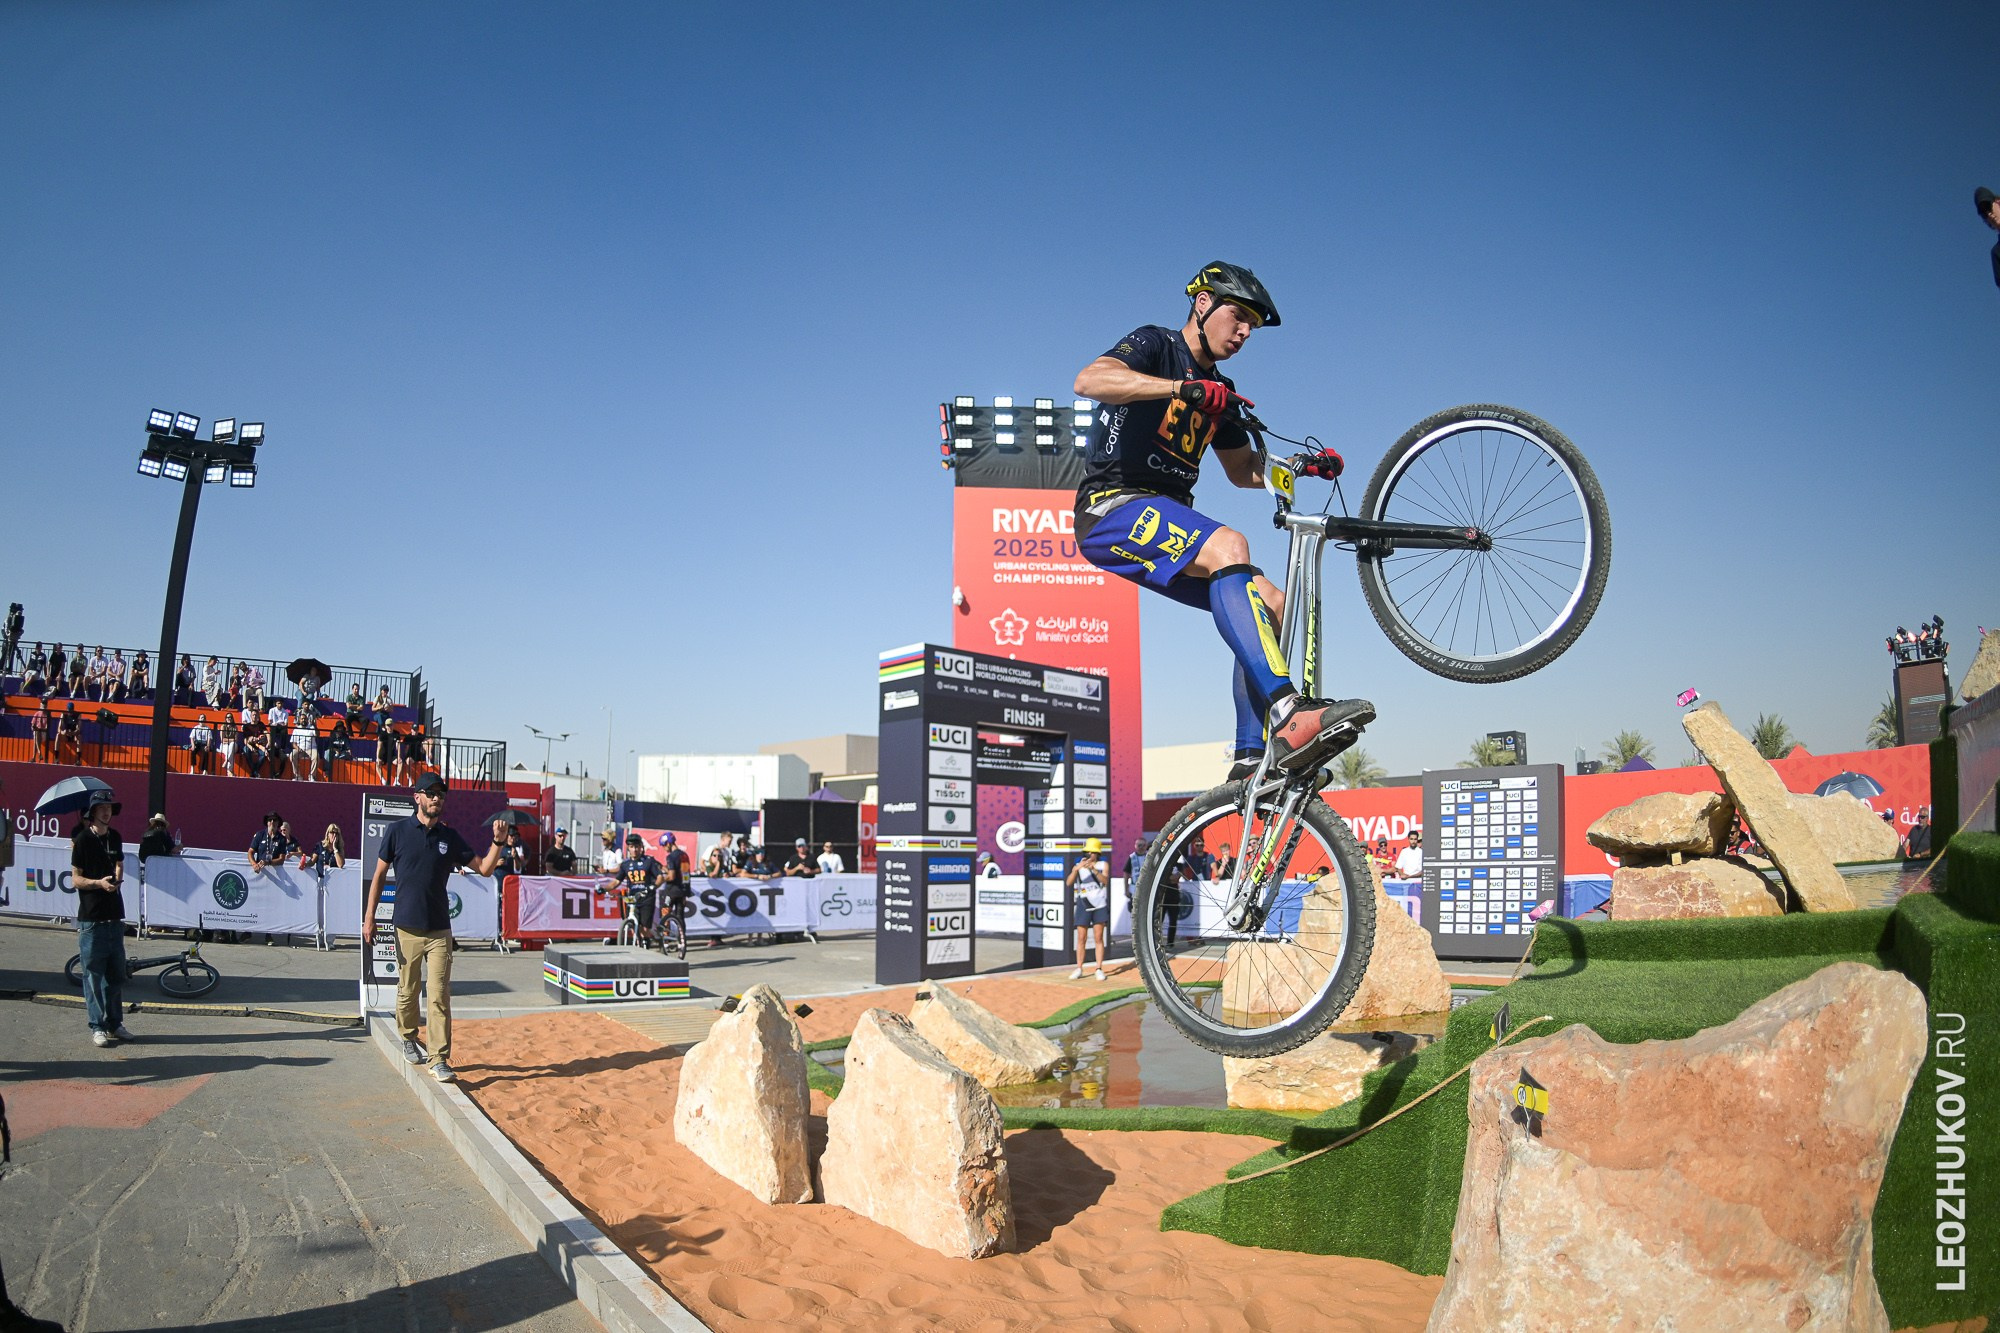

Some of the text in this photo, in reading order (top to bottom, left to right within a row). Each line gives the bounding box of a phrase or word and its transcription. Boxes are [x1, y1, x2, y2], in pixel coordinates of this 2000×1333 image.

[1477, 410, 1499, 419] TIRE
[1283, 474, 1290, 490] 6
[993, 539, 1053, 557] 2025
[993, 562, 1027, 571] URBAN
[1028, 563, 1070, 571] CYCLING
[993, 573, 1105, 586] CHAMPIONSHIPS
[1035, 616, 1109, 632] وزارة الرياضة
[1035, 632, 1109, 644] Ministry of Sport
[1397, 630, 1470, 671] THE NATIONAL
[941, 656, 971, 676] UCI
[1004, 708, 1045, 727] FINISH
[939, 728, 967, 745] UCI
[1073, 746, 1106, 757] SHIMANO
[935, 789, 966, 798] TISSOT
[16, 808, 60, 838] وزارة
[941, 840, 958, 848] UCI
[928, 864, 970, 874] SHIMANO
[1029, 863, 1063, 872] SHIMANO
[627, 870, 646, 882] ESP
[1035, 908, 1059, 922] UCI
[936, 916, 965, 932] UCI
[557, 969, 569, 989] UCI
[615, 980, 655, 997] UCI
